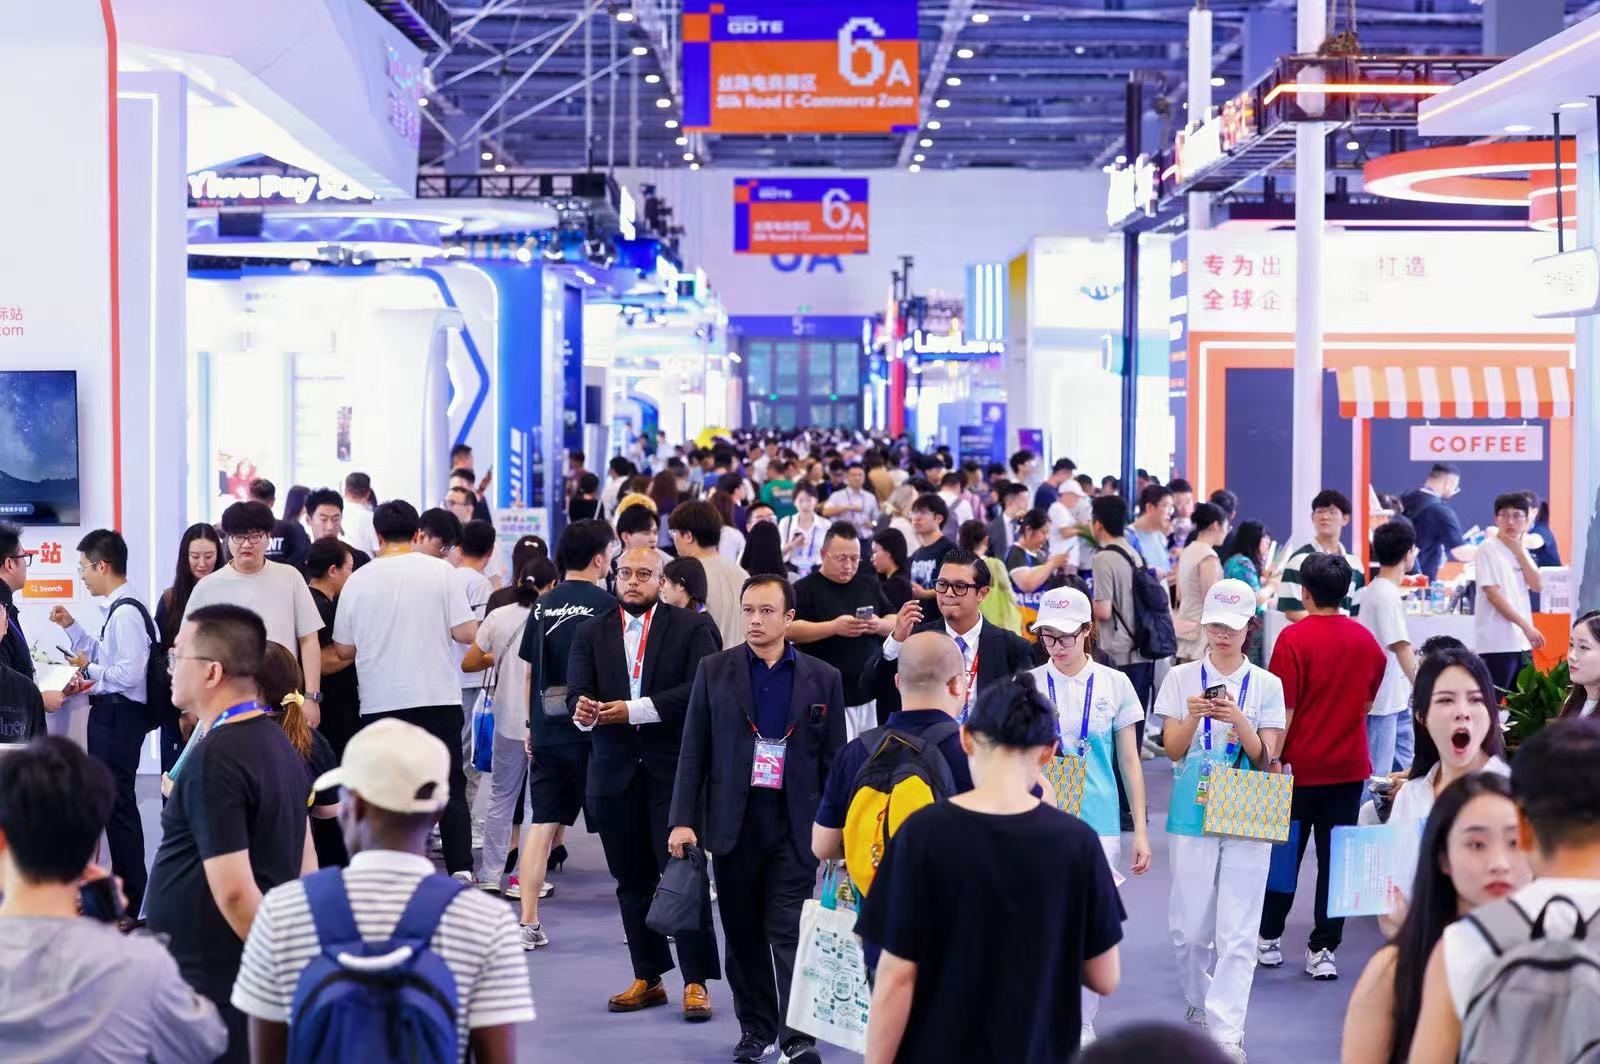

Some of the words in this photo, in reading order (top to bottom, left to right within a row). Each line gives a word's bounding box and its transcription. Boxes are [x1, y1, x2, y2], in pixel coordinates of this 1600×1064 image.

[838, 17, 911, 87] 6A
[878, 93, 914, 108] Zone
[0, 327, 24, 336] om
[1430, 436, 1526, 453] COFFEE
[39, 585, 63, 593] Search
